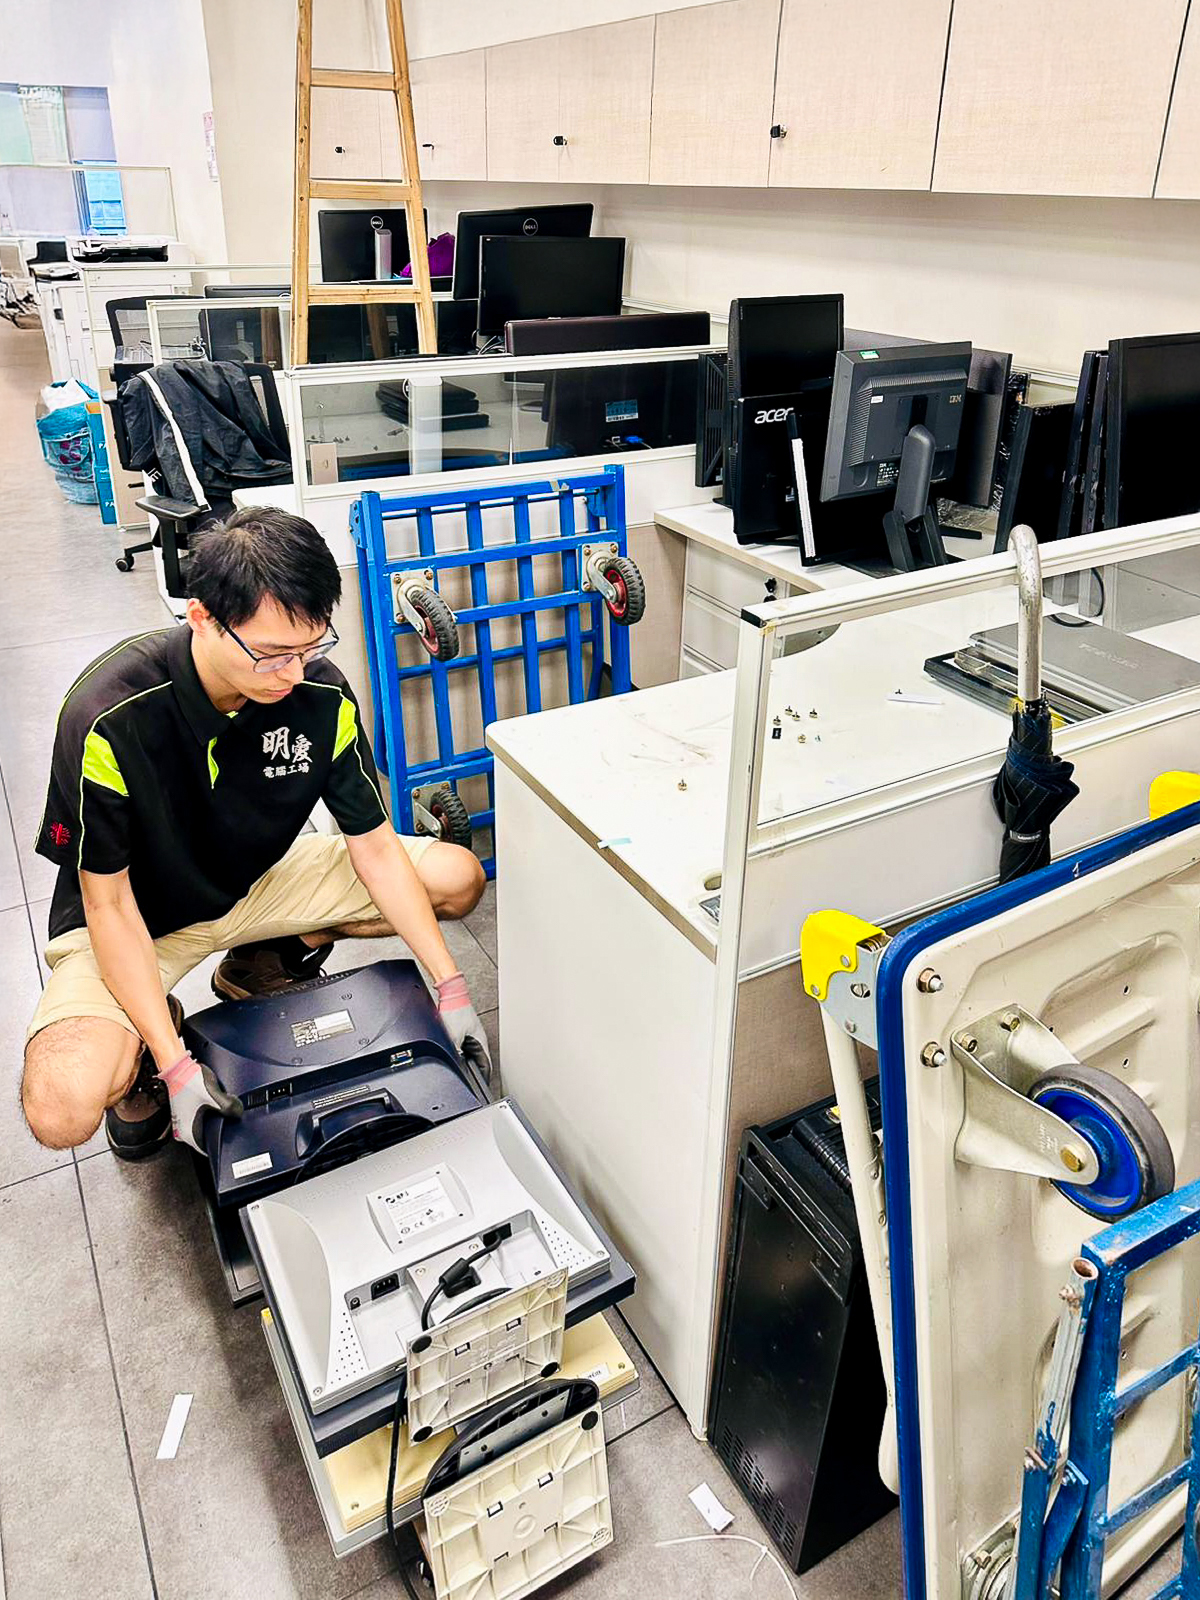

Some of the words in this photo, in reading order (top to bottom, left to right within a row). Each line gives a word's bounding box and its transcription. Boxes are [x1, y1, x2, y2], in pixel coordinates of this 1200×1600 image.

[949, 394, 962, 404] IBM
[754, 407, 794, 424] acer
[261, 726, 313, 763] 明愛
[263, 762, 310, 779] 電腦工場
